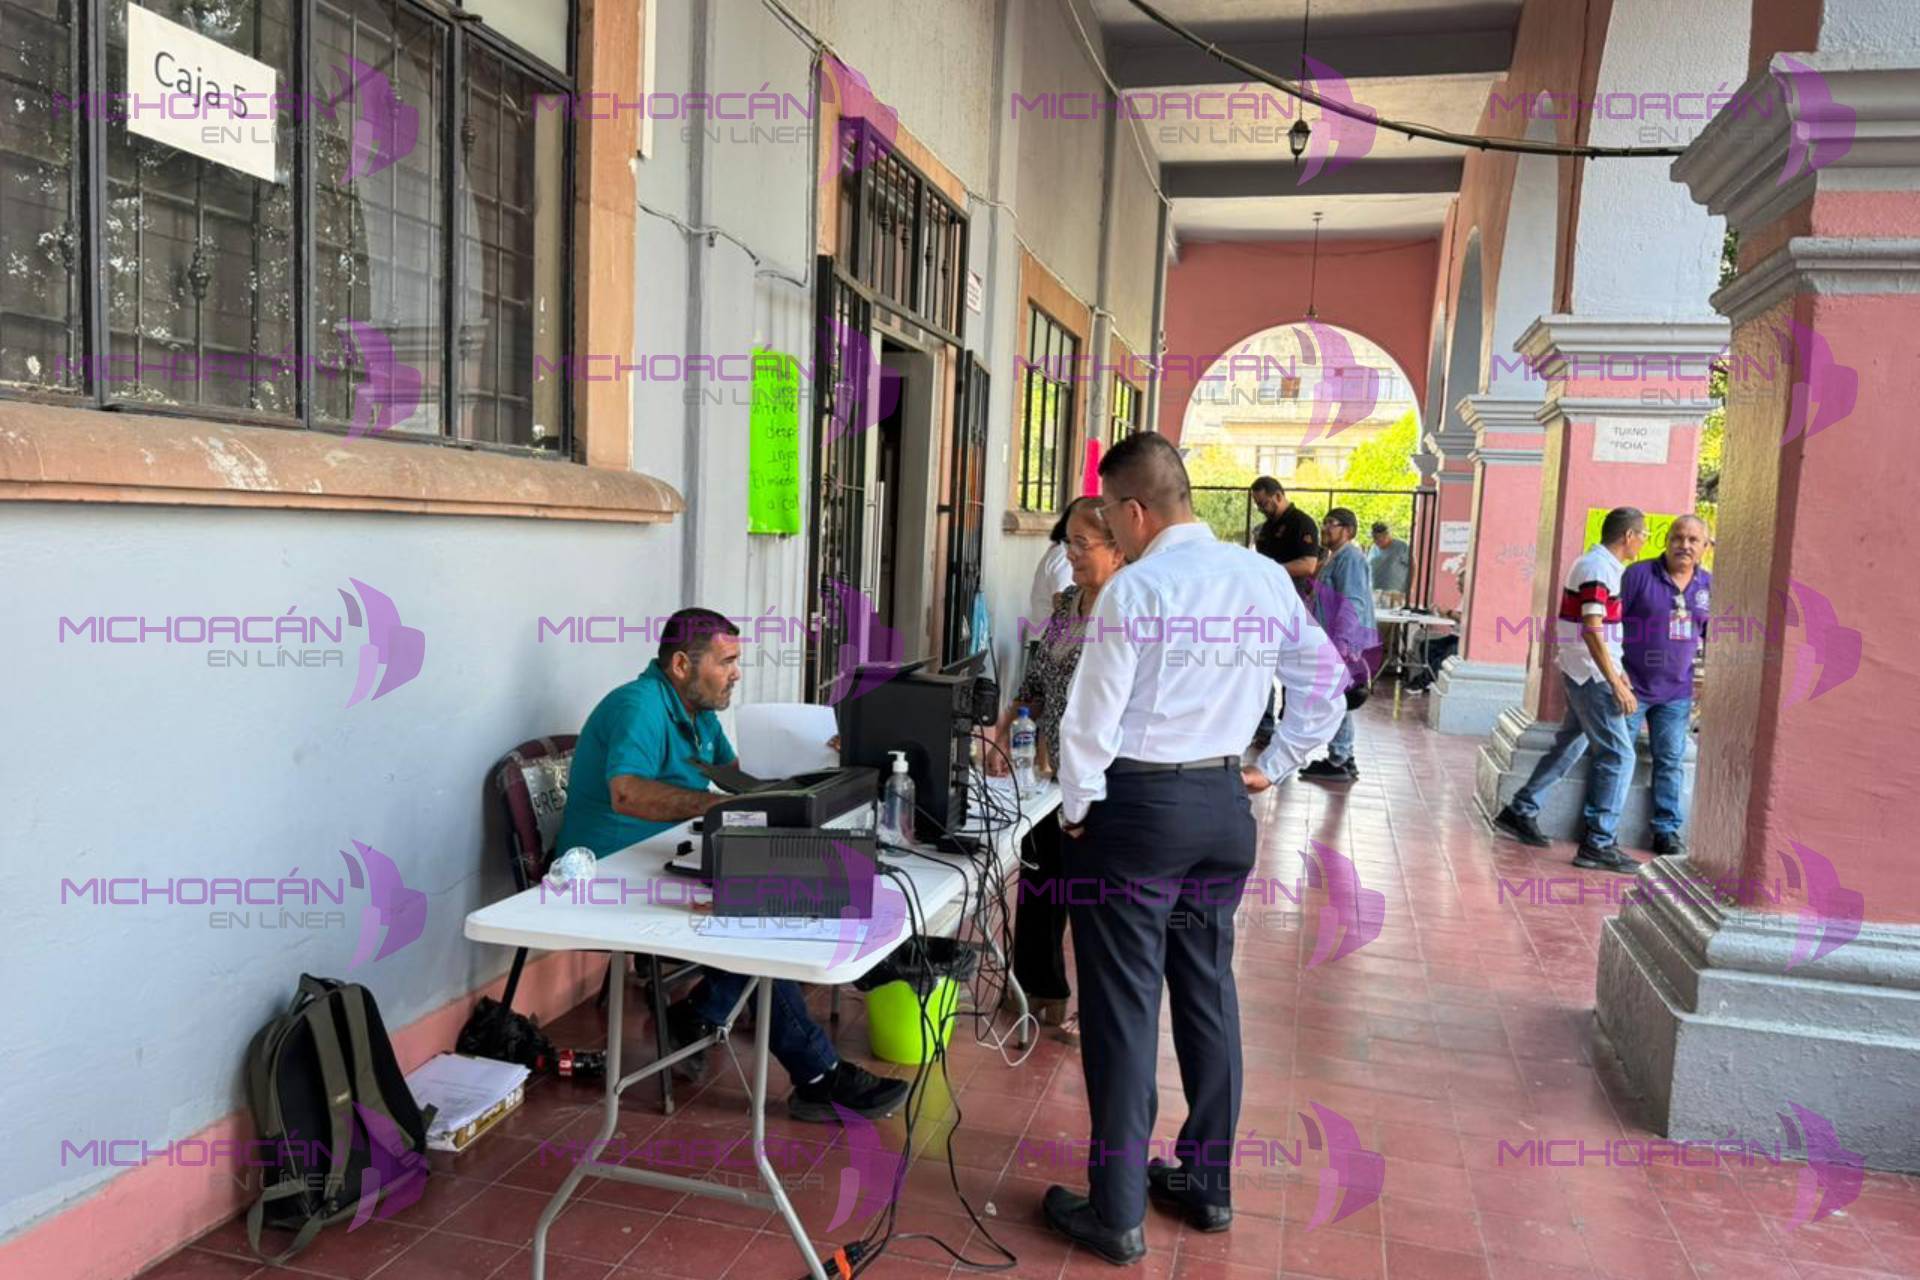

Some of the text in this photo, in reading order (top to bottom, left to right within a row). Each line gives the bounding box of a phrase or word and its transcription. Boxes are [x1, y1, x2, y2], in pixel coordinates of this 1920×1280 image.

[154, 51, 248, 118] Caja 5
[1613, 426, 1648, 437] TURNO
